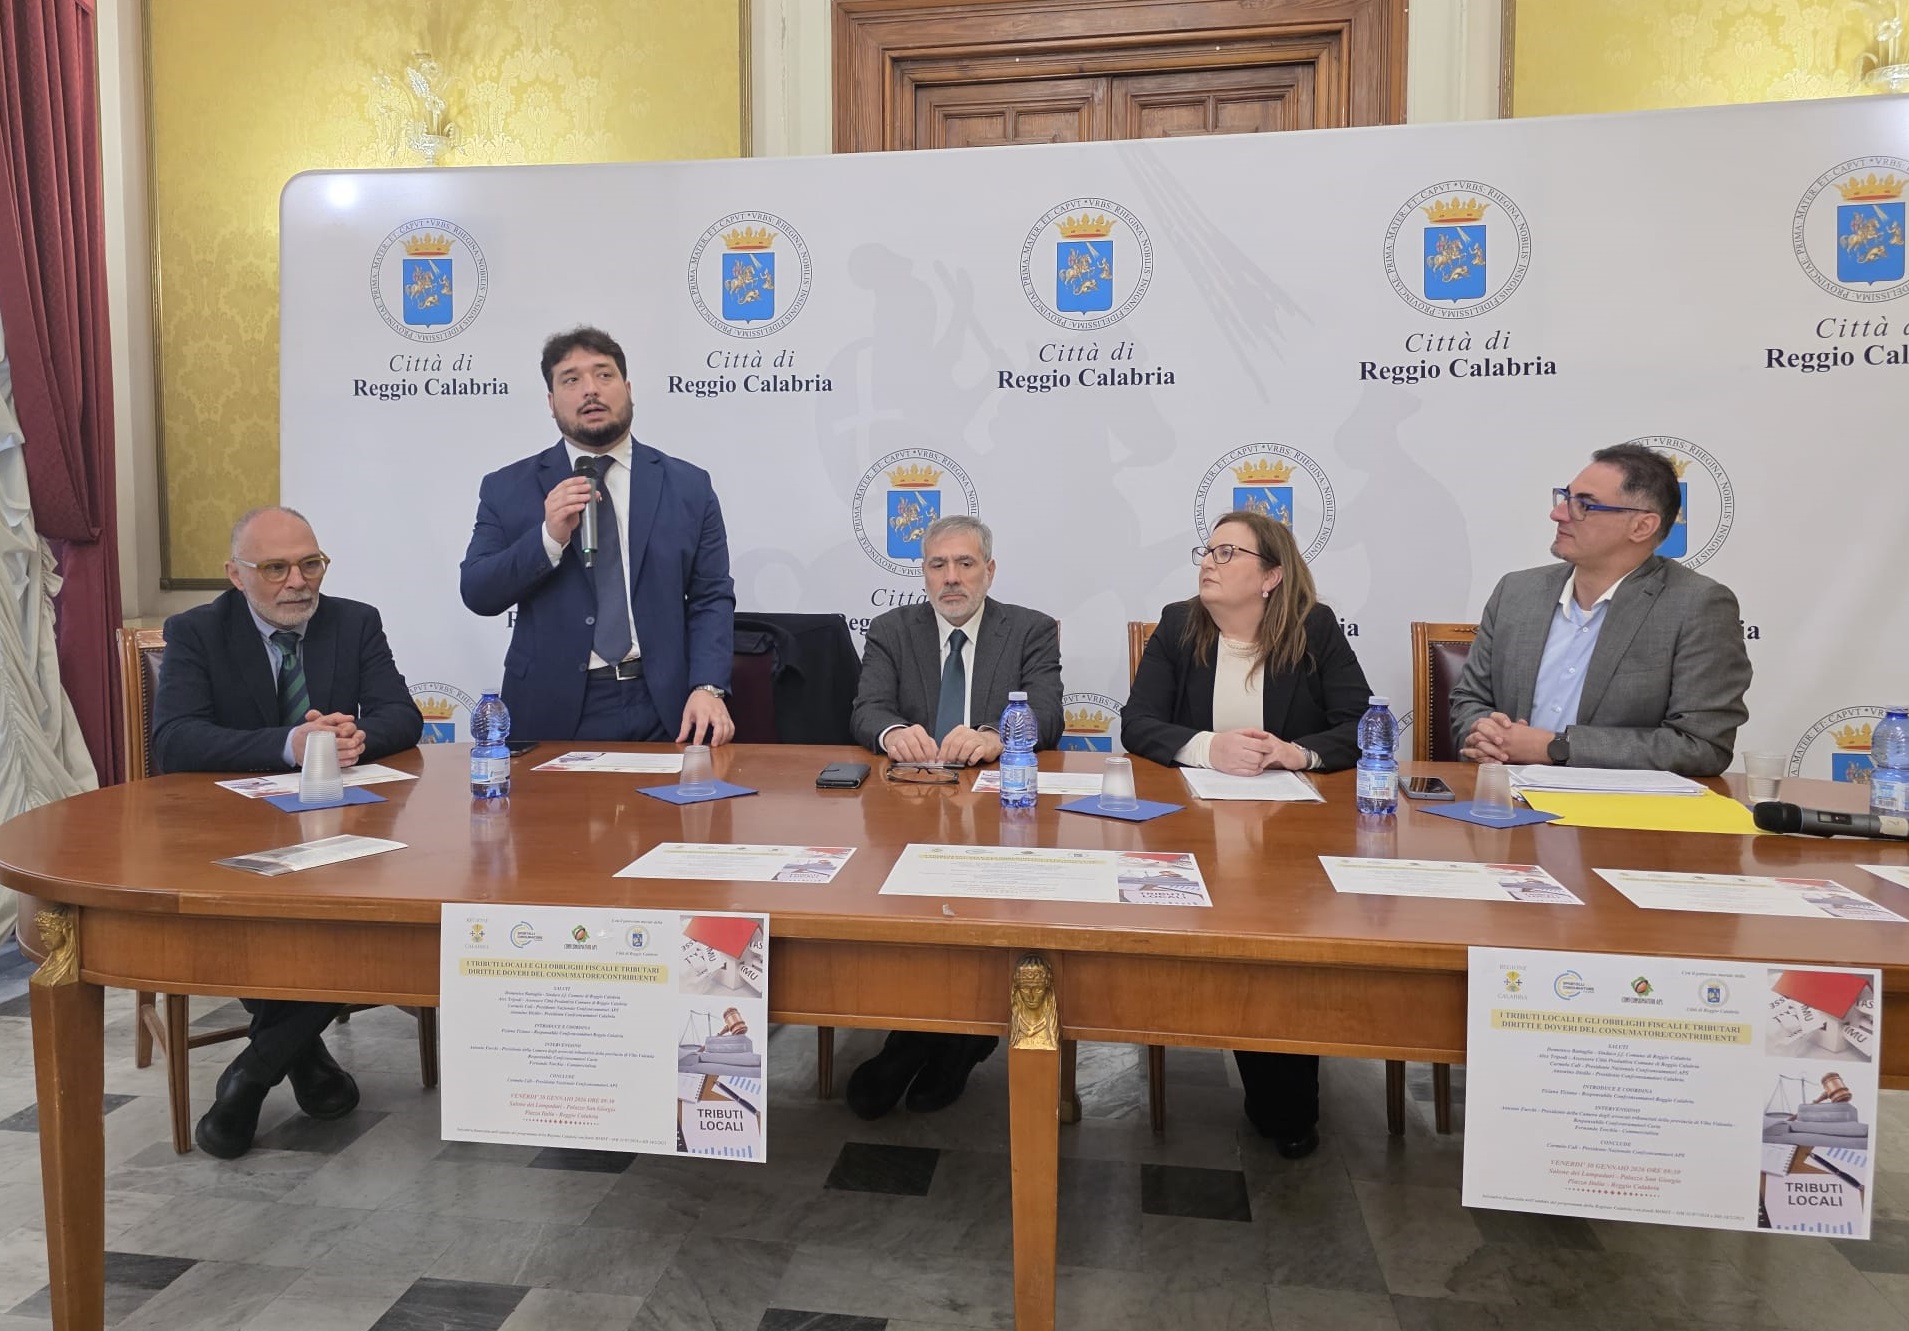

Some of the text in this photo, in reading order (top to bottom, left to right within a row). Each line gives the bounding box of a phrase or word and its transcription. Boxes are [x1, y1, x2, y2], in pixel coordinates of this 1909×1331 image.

[1832, 159, 1865, 175] CAPVT
[1418, 183, 1449, 198] CAPVT
[1052, 200, 1080, 215] CAPVT
[718, 213, 744, 227] CAPVT
[1816, 316, 1888, 338] Città
[1405, 330, 1511, 352] Città di
[707, 350, 795, 368] Città di
[1039, 342, 1134, 362] Città di
[1765, 347, 1854, 373] Reggio
[389, 354, 472, 372] Città di
[1359, 356, 1557, 384] Reggio Calabria
[668, 374, 832, 398] Reggio Calabria
[997, 367, 1175, 393] Reggio Calabria
[353, 378, 509, 401] Reggio Calabria
[884, 450, 911, 463] CAPVT
[1230, 445, 1259, 460] CAPVT
[871, 588, 927, 607] Città
[1828, 708, 1860, 723] CAPVT
[741, 966, 759, 980] IMU
[1502, 1021, 1536, 1029] DIRITTI
[1544, 1024, 1577, 1032] DOVERI
[1599, 1027, 1737, 1042] CONSUMATORE/CONTRIBUENTE
[1506, 1012, 1540, 1020] TRIBUTI
[1542, 1014, 1575, 1023] LOCALI
[1602, 1018, 1645, 1027] OBBLIGHI
[1648, 1021, 1682, 1030] FISCALI
[1693, 1024, 1740, 1034] TRIBUTARI
[1843, 1025, 1867, 1043] IMU
[696, 1109, 743, 1119] TRIBUTI
[700, 1121, 743, 1131] LOCALI
[1785, 1182, 1843, 1193] TRIBUTI
[1788, 1196, 1843, 1206] LOCALI
